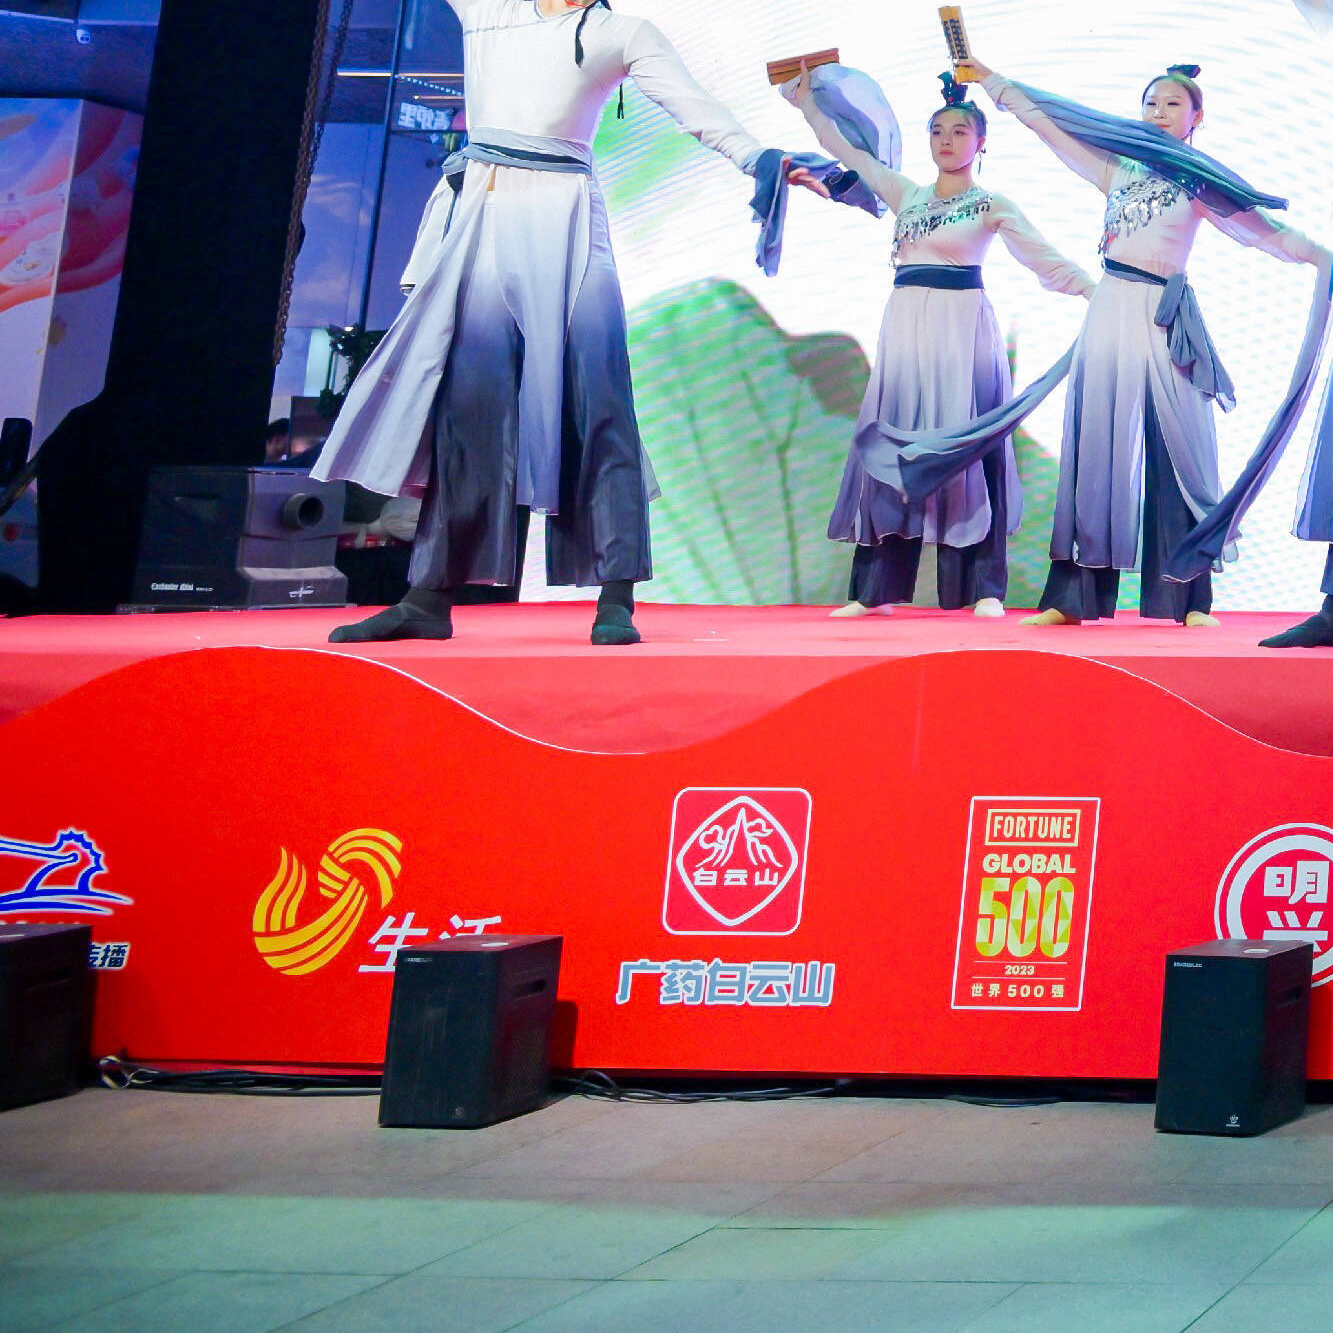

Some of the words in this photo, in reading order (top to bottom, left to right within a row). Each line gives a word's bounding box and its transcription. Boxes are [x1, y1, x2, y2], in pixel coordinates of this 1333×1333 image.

[993, 815, 1073, 839] FORTUNE
[982, 853, 1076, 874] GLOBAL
[692, 868, 779, 886] 白云山
[975, 876, 1075, 958] 500
[1004, 964, 1035, 976] 2023
[615, 958, 836, 1006] 广药白云山
